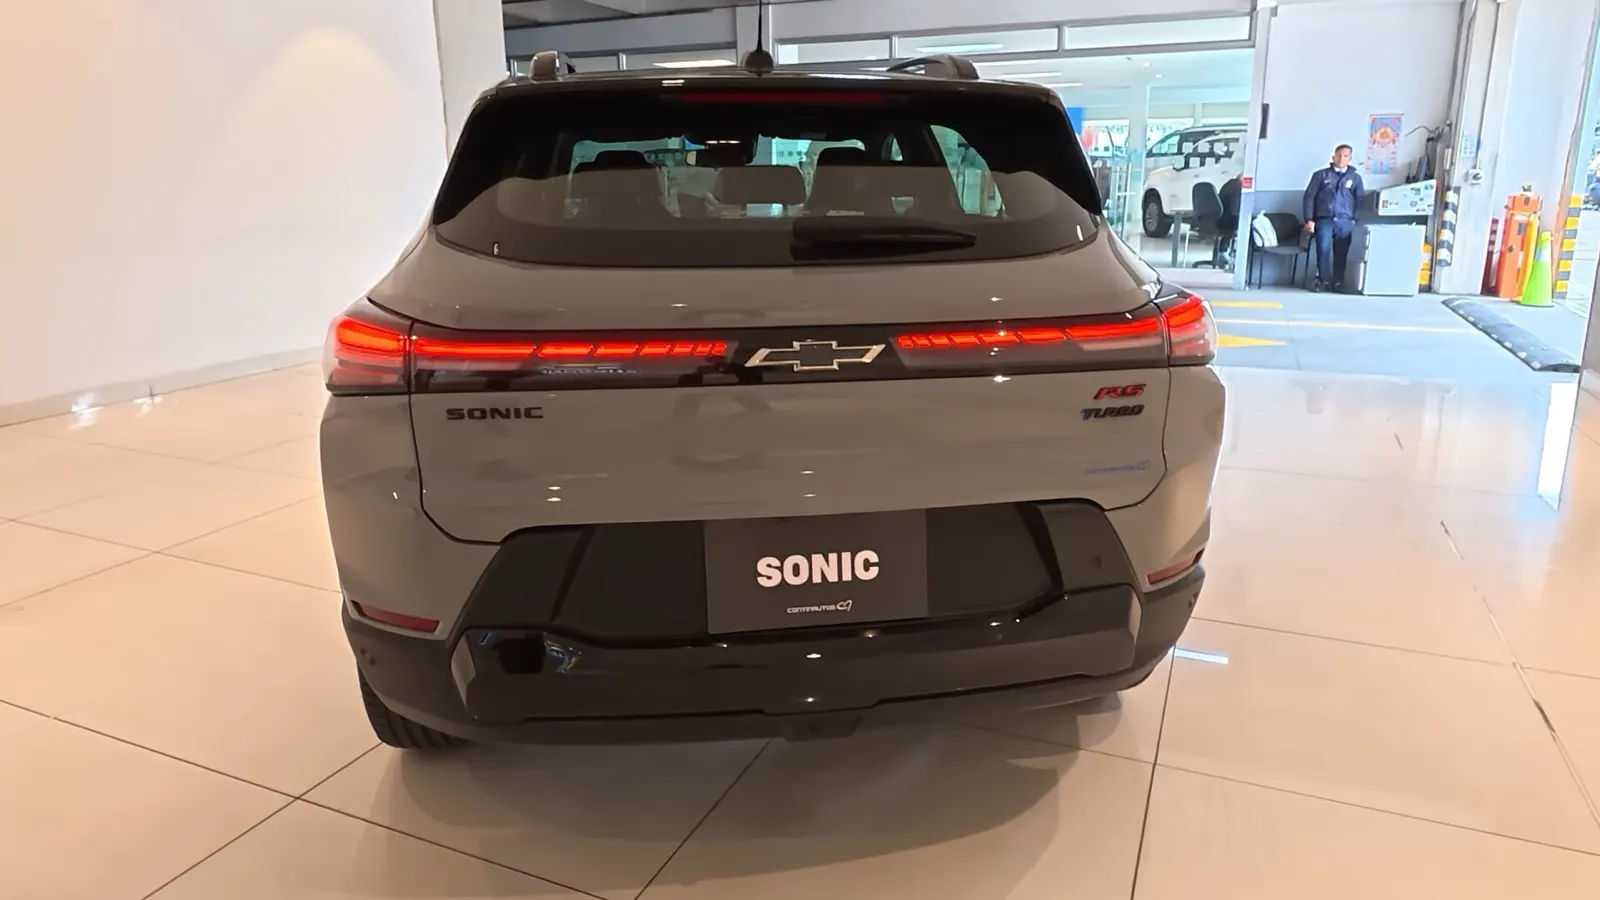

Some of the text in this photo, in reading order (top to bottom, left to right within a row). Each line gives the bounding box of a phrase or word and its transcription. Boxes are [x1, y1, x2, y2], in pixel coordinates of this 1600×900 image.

[1093, 384, 1147, 400] RS
[446, 407, 544, 420] SONIC
[1081, 404, 1145, 420] TURBO
[757, 550, 879, 587] SONIC
